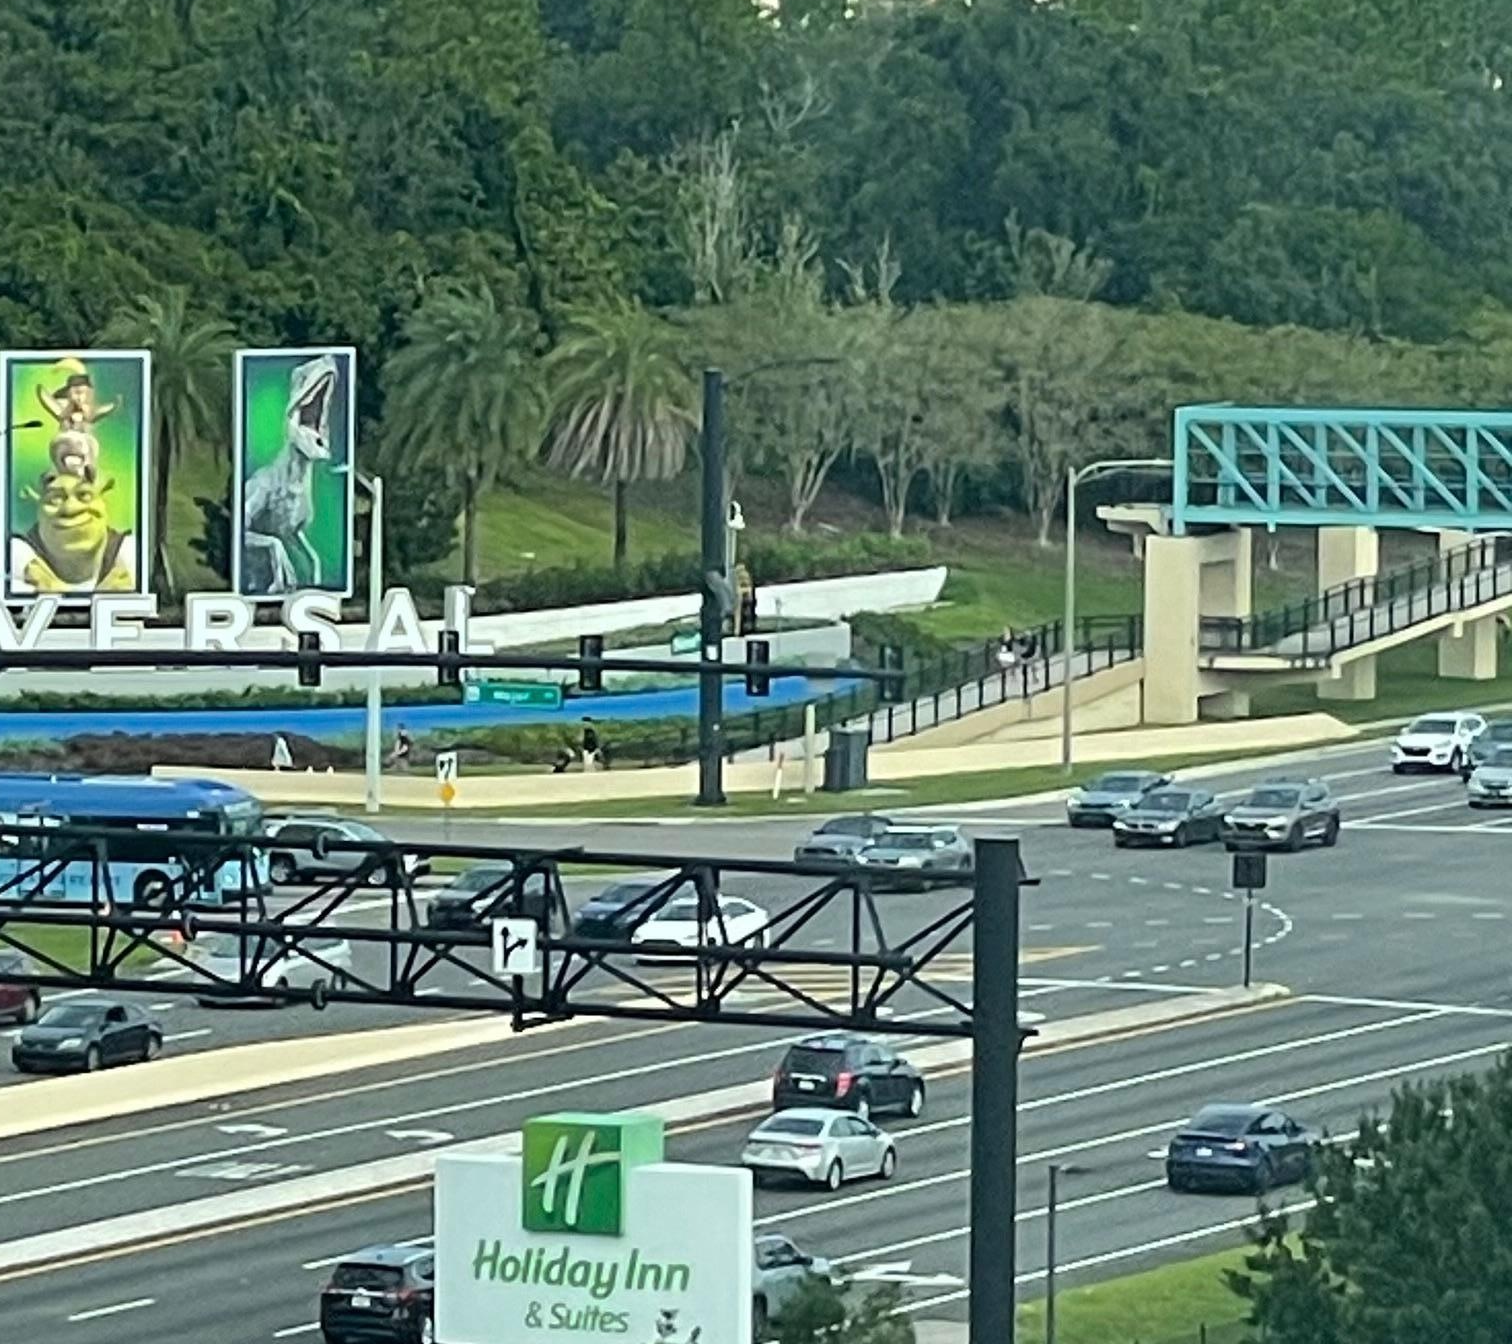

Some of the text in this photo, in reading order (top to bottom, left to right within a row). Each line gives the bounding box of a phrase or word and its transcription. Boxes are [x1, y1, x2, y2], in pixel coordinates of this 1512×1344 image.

[473, 1239, 691, 1300] Holiday Inn
[524, 1300, 630, 1334] & Suites
